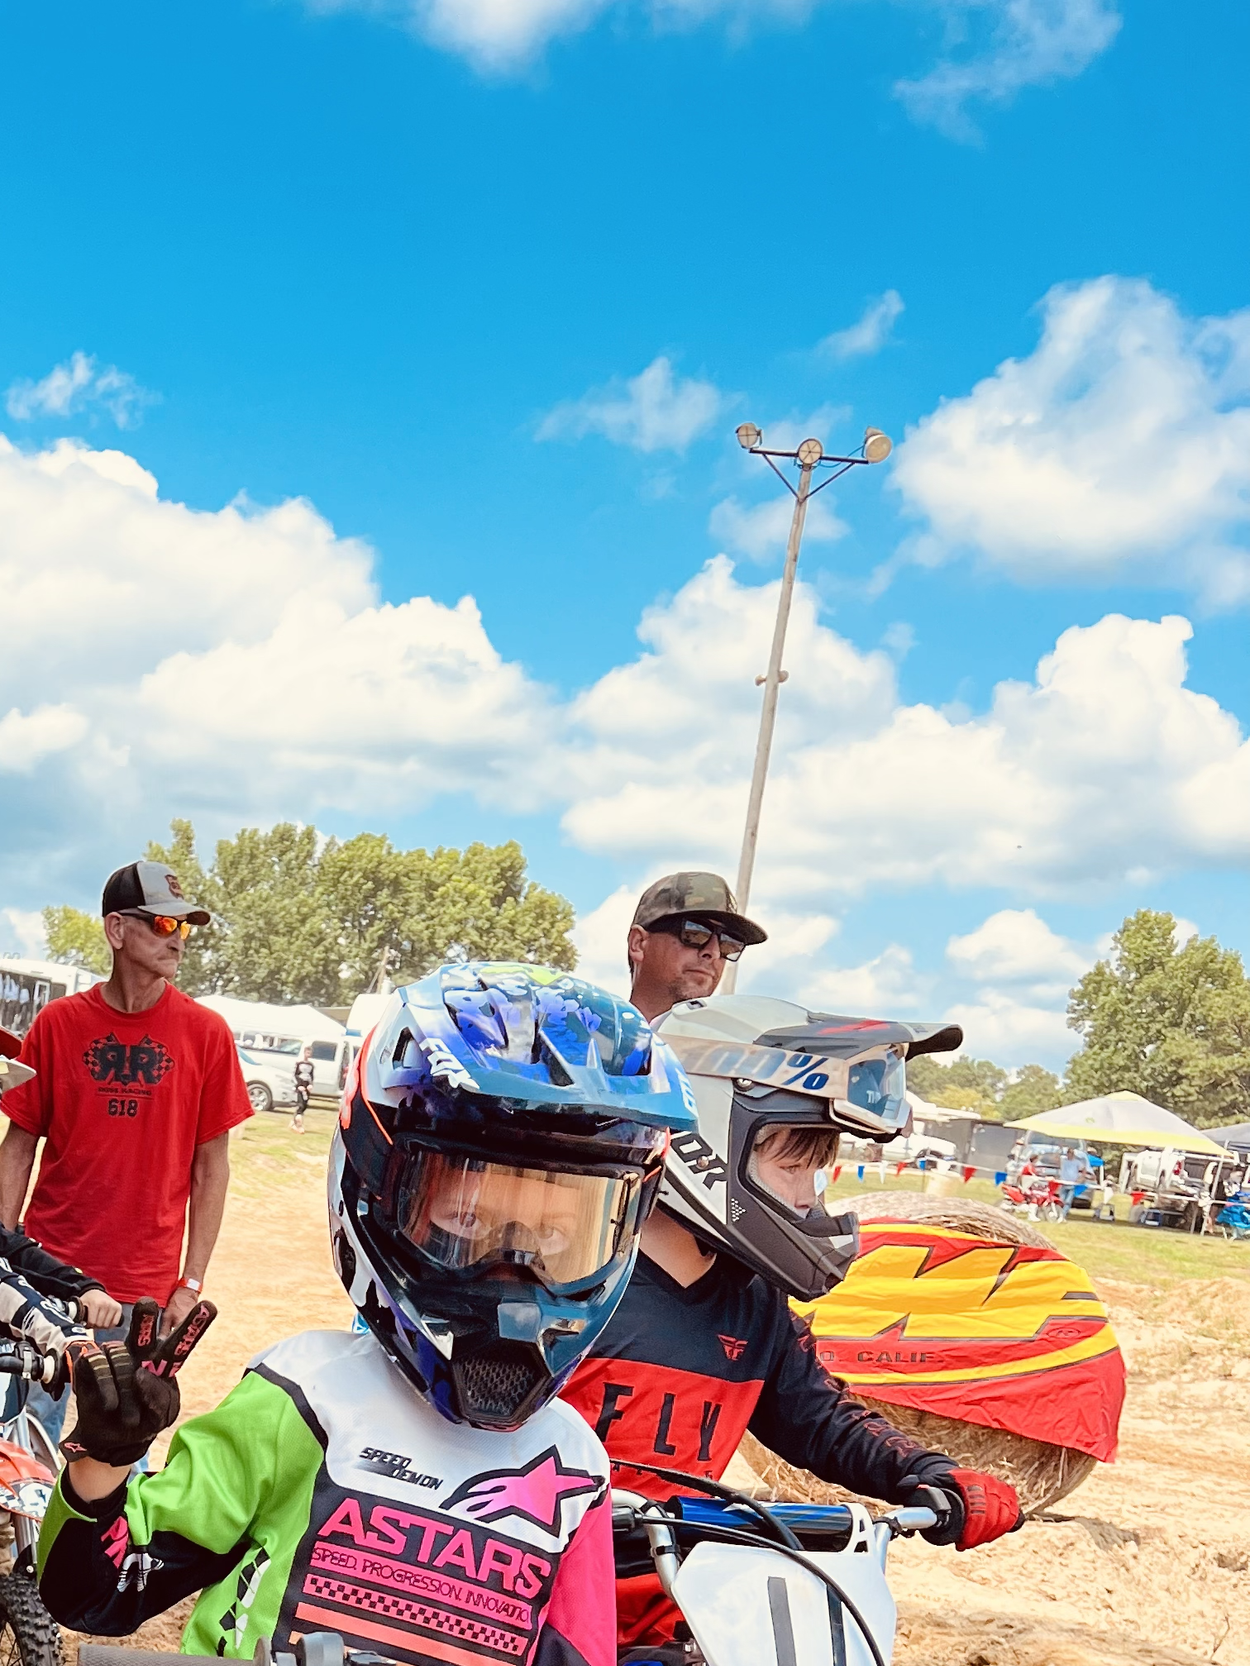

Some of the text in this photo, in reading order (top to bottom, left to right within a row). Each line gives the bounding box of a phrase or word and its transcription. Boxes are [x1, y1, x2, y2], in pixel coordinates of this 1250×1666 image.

[107, 1097, 139, 1118] 618
[857, 1350, 944, 1363] CALIF.
[594, 1381, 723, 1462] FLY
[359, 1447, 413, 1468] SPEED
[317, 1497, 552, 1600] ASTARS
[465, 1590, 531, 1624] INNOVATIO
